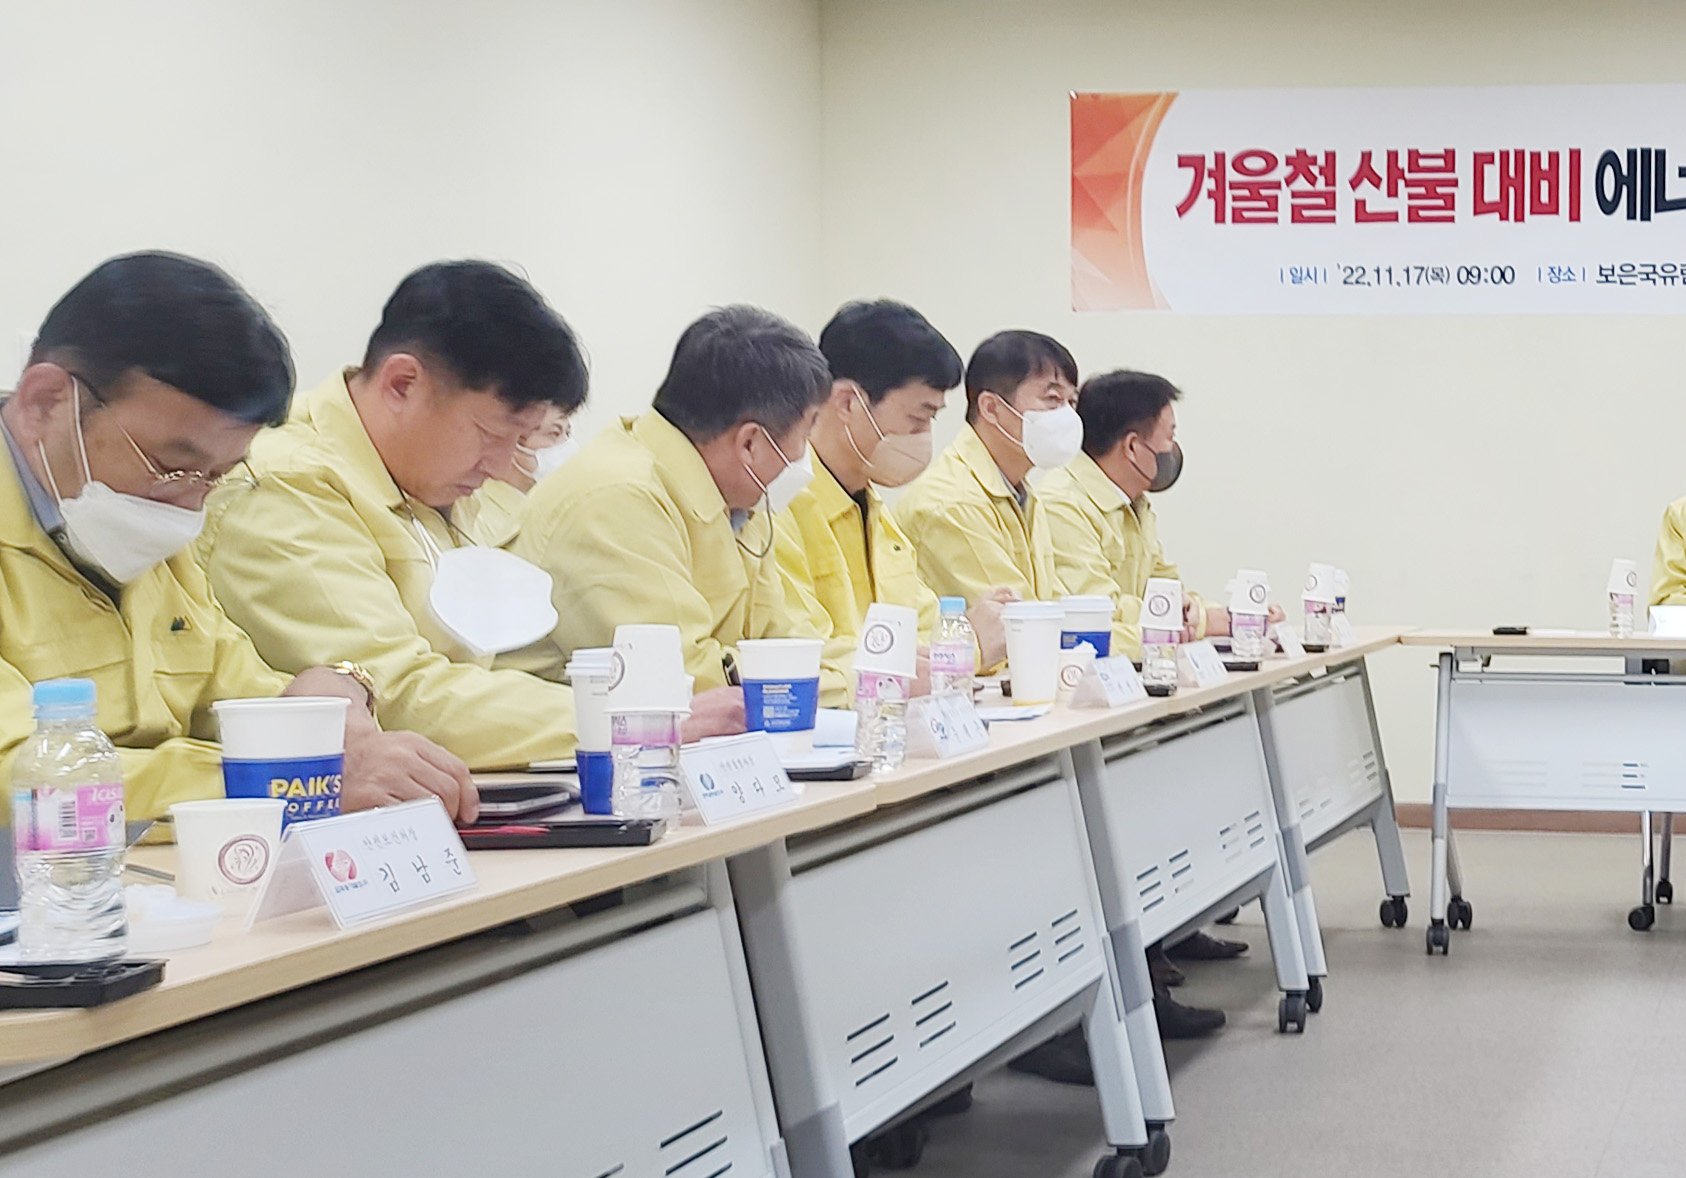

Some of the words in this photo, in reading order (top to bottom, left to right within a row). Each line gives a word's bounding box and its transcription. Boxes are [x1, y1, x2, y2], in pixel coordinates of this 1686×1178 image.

[1175, 147, 1337, 225] 겨울철
[1347, 147, 1460, 224] 산불
[1472, 147, 1582, 224] 대비
[1456, 265, 1516, 286] 09:00
[270, 774, 342, 798] PAIK'S
